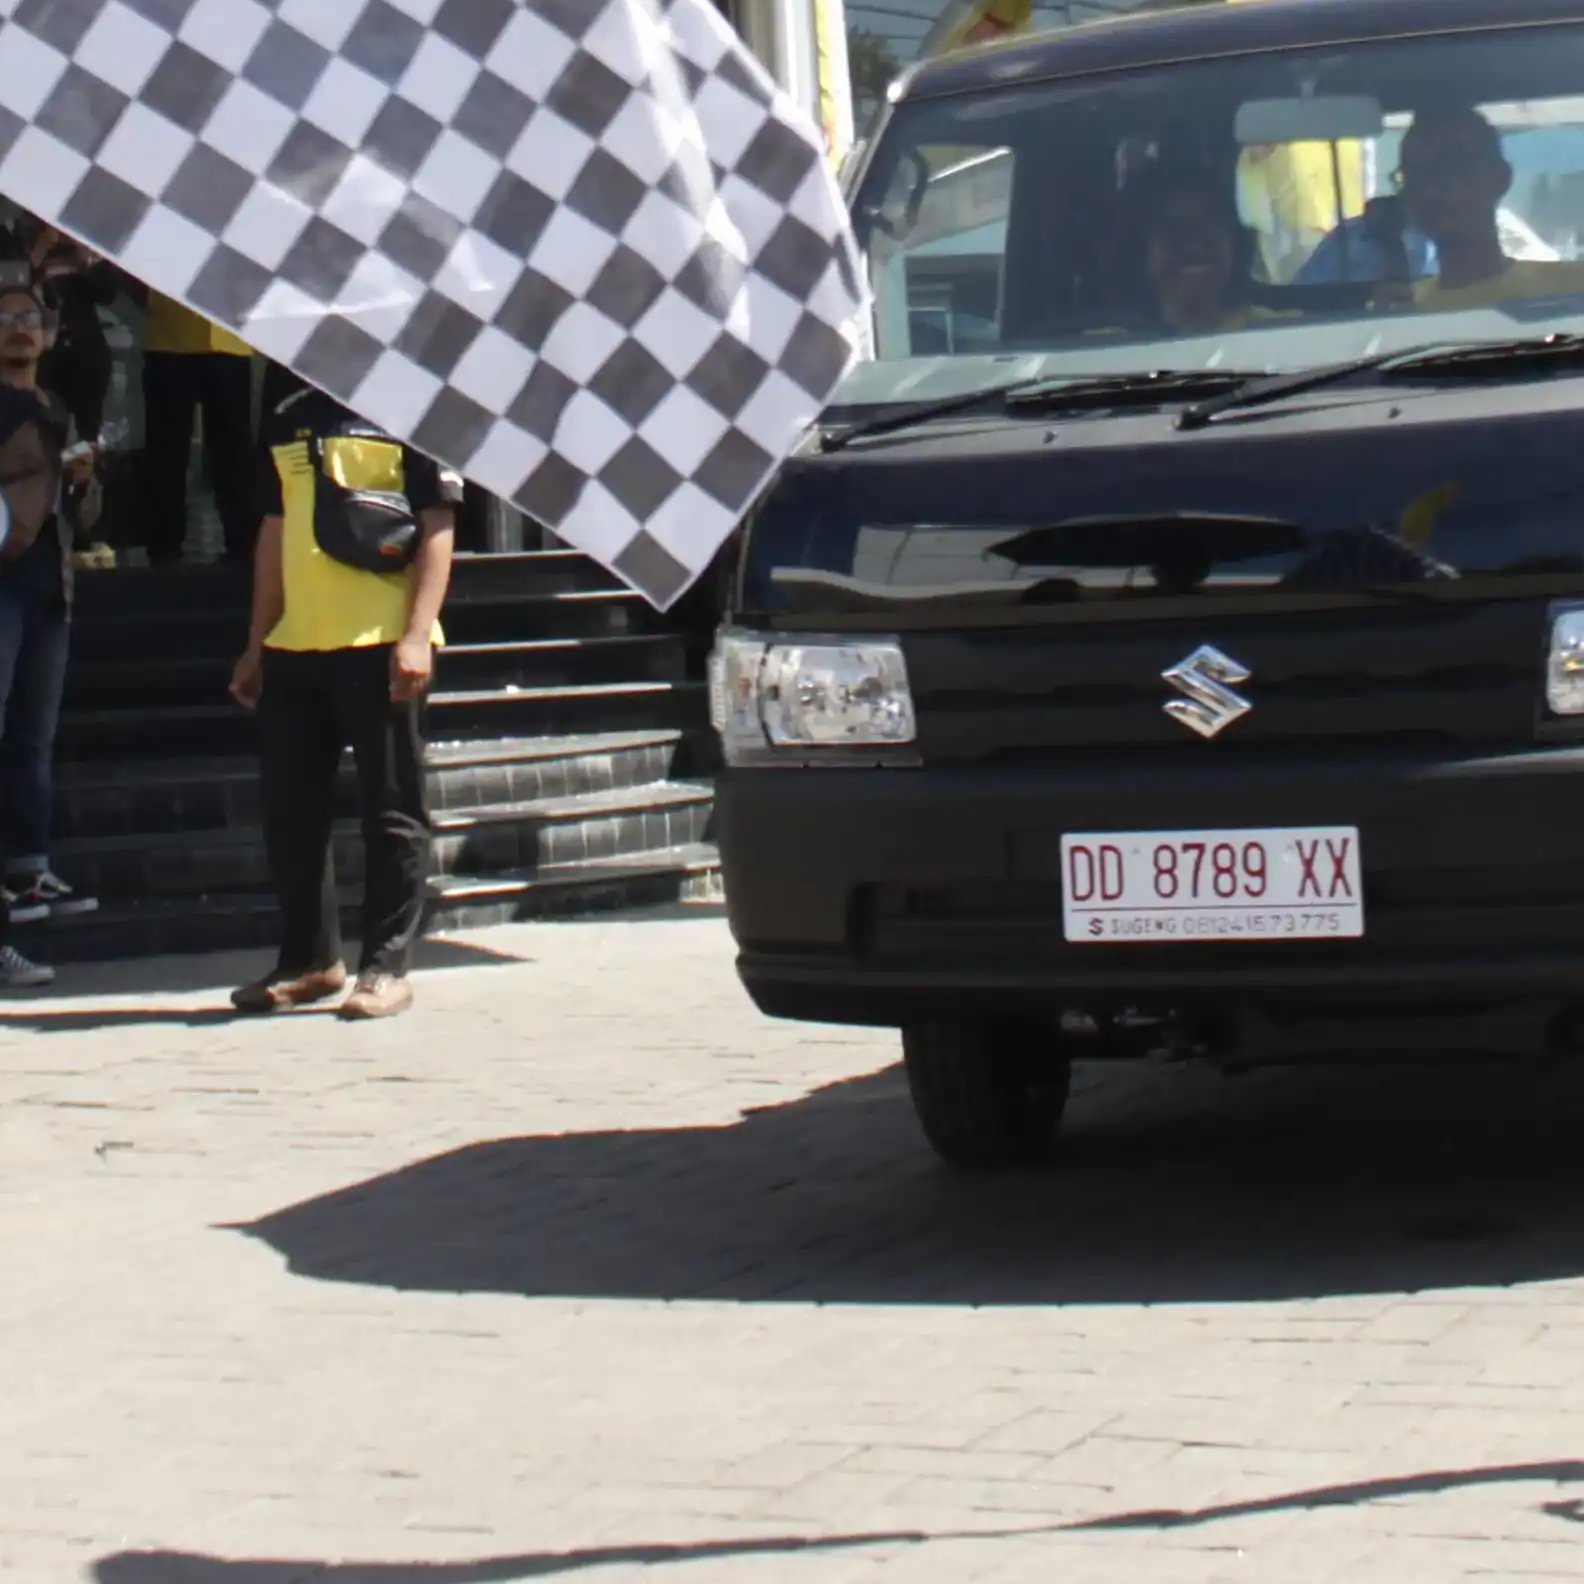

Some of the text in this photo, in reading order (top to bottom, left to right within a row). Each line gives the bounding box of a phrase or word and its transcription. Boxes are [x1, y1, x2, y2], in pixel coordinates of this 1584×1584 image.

[1068, 837, 1353, 902] DD 8789 XX
